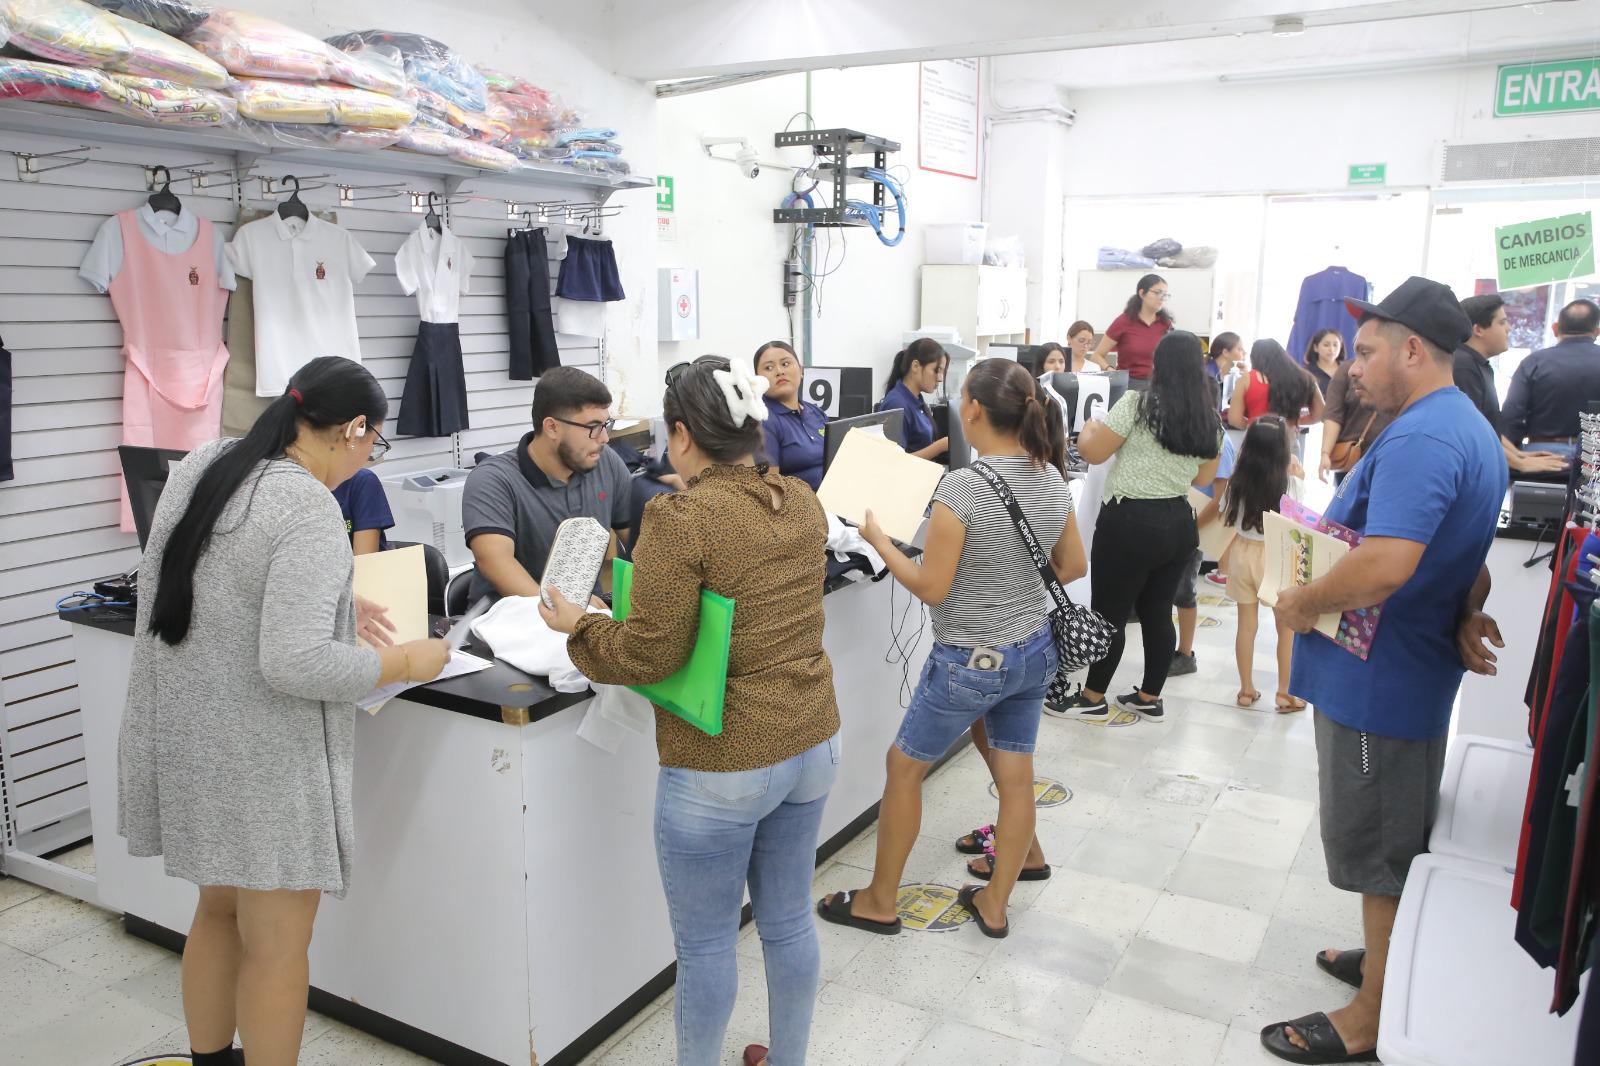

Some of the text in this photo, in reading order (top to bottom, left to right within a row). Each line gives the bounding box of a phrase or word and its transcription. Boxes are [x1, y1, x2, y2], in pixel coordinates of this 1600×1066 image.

[1504, 68, 1600, 107] ENTRA
[1499, 223, 1586, 250] CAMBIOS
[1503, 247, 1581, 271] DE MERCANCIA
[810, 379, 832, 411] 9
[974, 463, 1004, 489] FASHION
[1017, 518, 1039, 553] FASHION
[1049, 580, 1071, 612] FASHION
